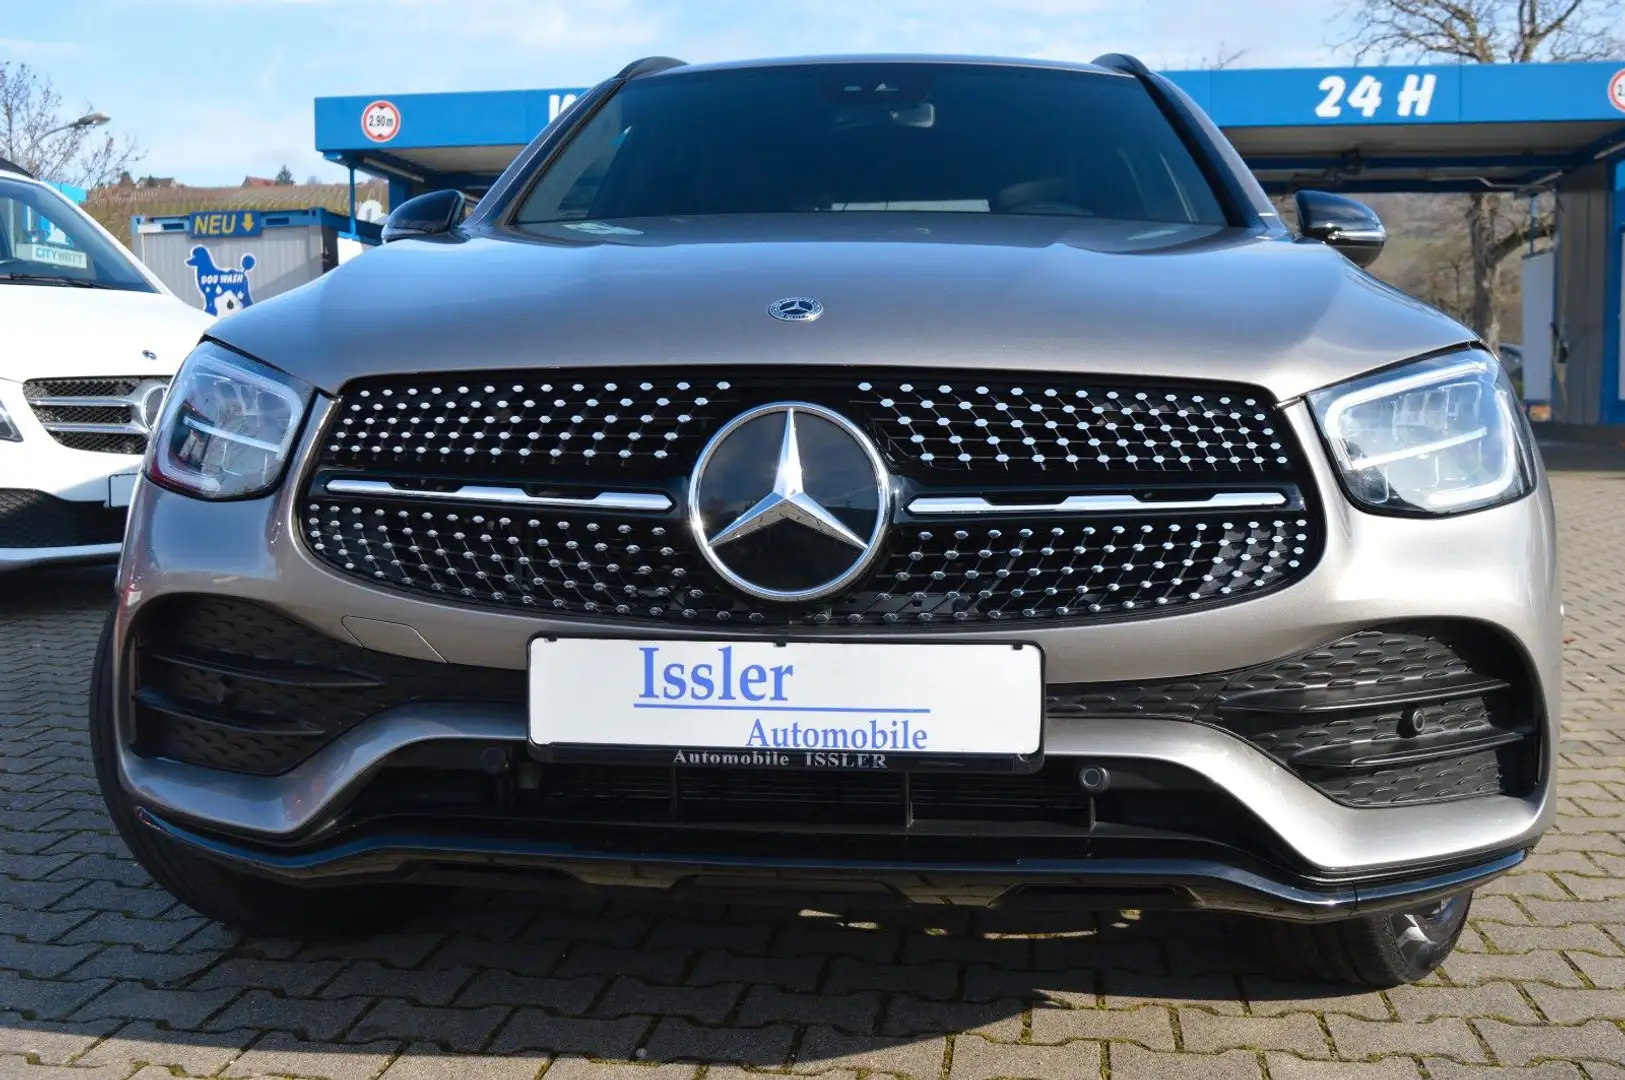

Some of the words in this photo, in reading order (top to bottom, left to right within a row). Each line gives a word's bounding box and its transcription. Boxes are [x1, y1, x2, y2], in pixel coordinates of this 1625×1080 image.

[1315, 75, 1382, 118] 24
[1397, 73, 1437, 117] H
[194, 215, 237, 235] NEU
[201, 275, 219, 285] DOG
[220, 273, 244, 284] WASH
[637, 645, 794, 702] Issler
[745, 718, 928, 751] Automobile
[673, 749, 790, 766] Automobile
[805, 751, 888, 769] ISSLER
